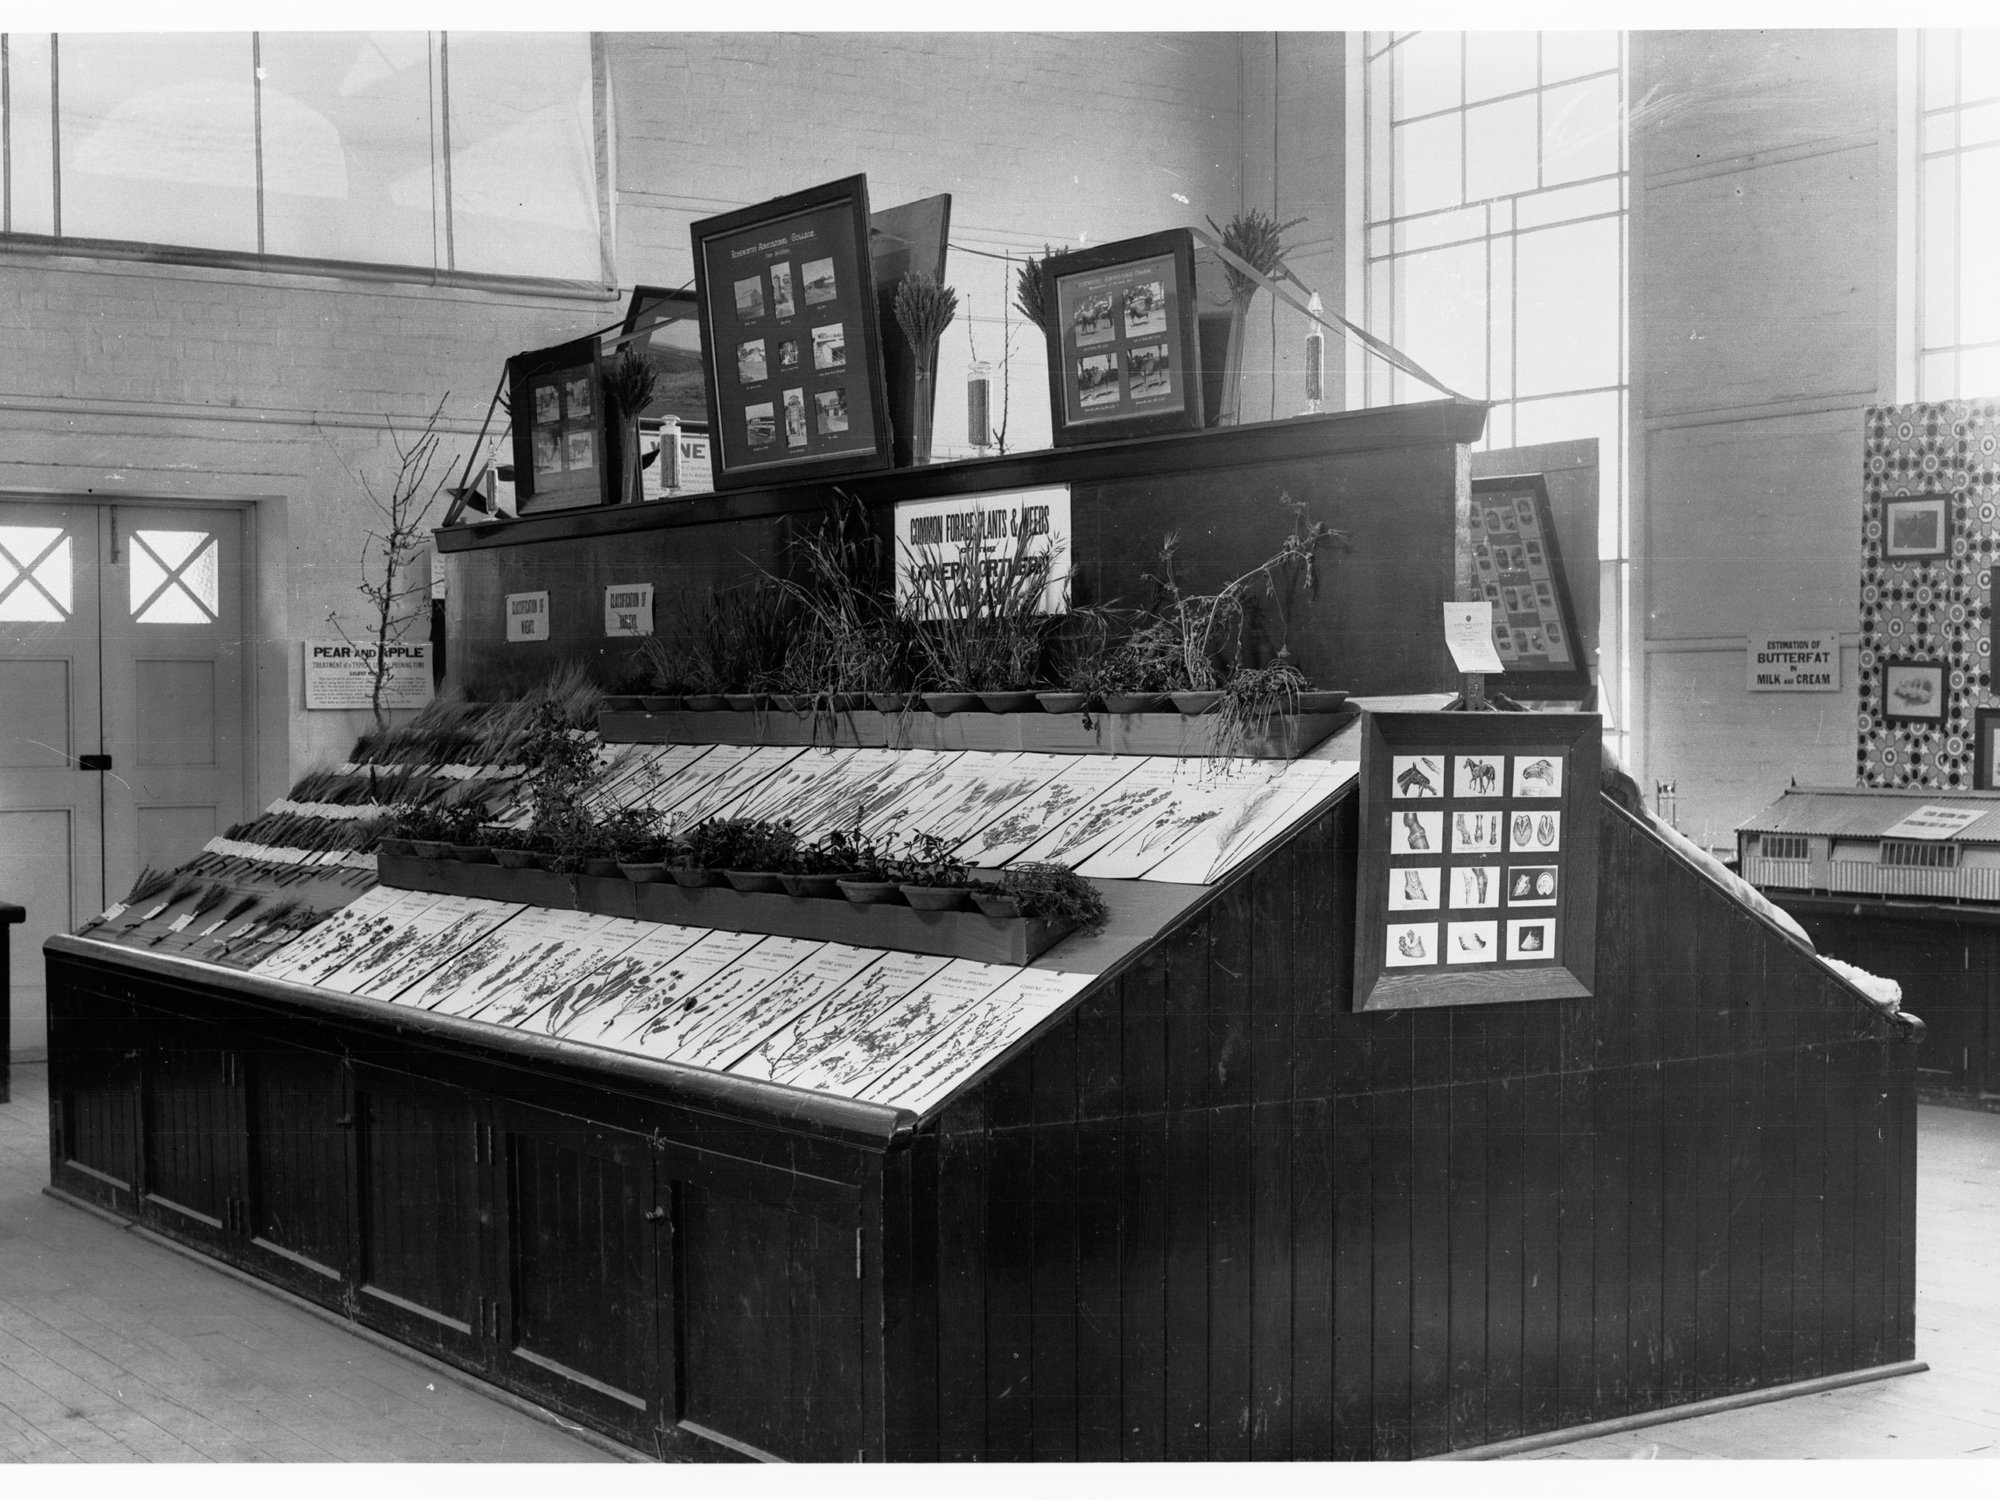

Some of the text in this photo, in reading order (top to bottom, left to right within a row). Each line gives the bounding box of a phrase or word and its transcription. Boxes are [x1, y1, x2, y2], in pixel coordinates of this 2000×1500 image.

[650, 441, 705, 459] WNE
[910, 505, 1049, 546] COMMON FORAGE PLANTS & WEEDS
[963, 555, 1049, 579] ORTERN
[1767, 640, 1821, 650] ESTIMATION OF
[314, 647, 424, 658] PEAR AND APPLE
[1757, 652, 1830, 664] BUTTERFAT
[1757, 673, 1781, 685] MILK
[1796, 673, 1830, 685] CREAM
